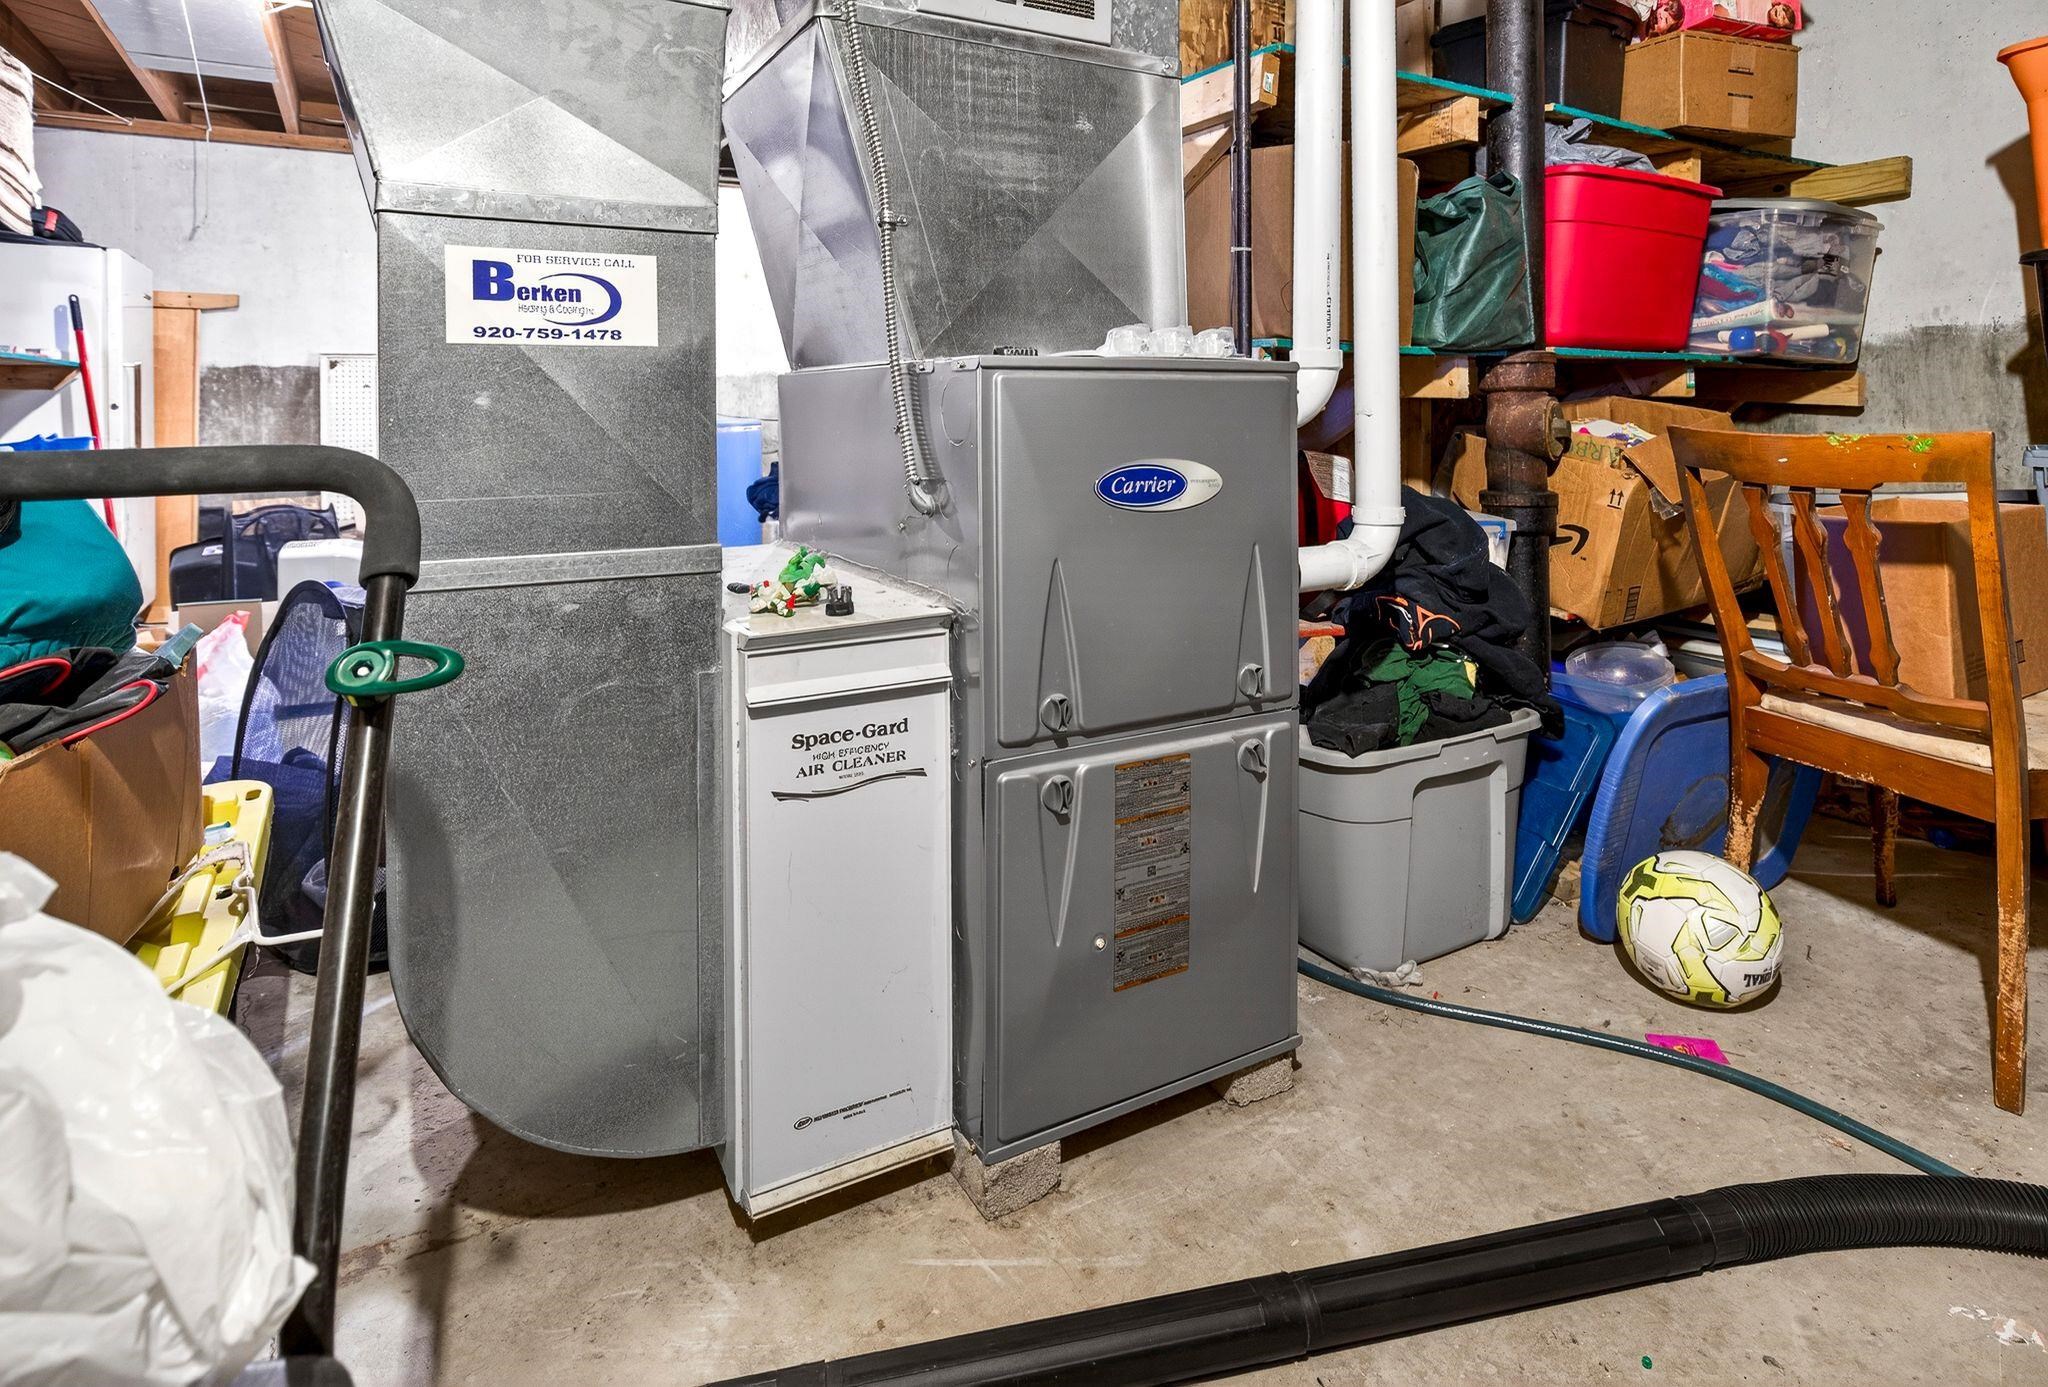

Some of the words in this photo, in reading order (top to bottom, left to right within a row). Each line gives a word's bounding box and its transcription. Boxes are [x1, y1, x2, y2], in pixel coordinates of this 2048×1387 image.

[517, 254, 541, 264] FOR
[545, 255, 600, 266] SERVICE
[604, 258, 635, 268] CALL
[472, 259, 582, 303] Berken
[518, 303, 547, 316] Heating
[549, 304, 555, 314] &
[555, 304, 586, 317] Cooling
[473, 326, 622, 341] 920-759-1478
[1111, 476, 1176, 494] Carrier
[792, 717, 909, 751] Space-Gard
[812, 751, 836, 761] HIGH
[838, 742, 890, 758] EFFICIENCY
[796, 763, 825, 778] AIR
[832, 750, 906, 771] CLEANER
